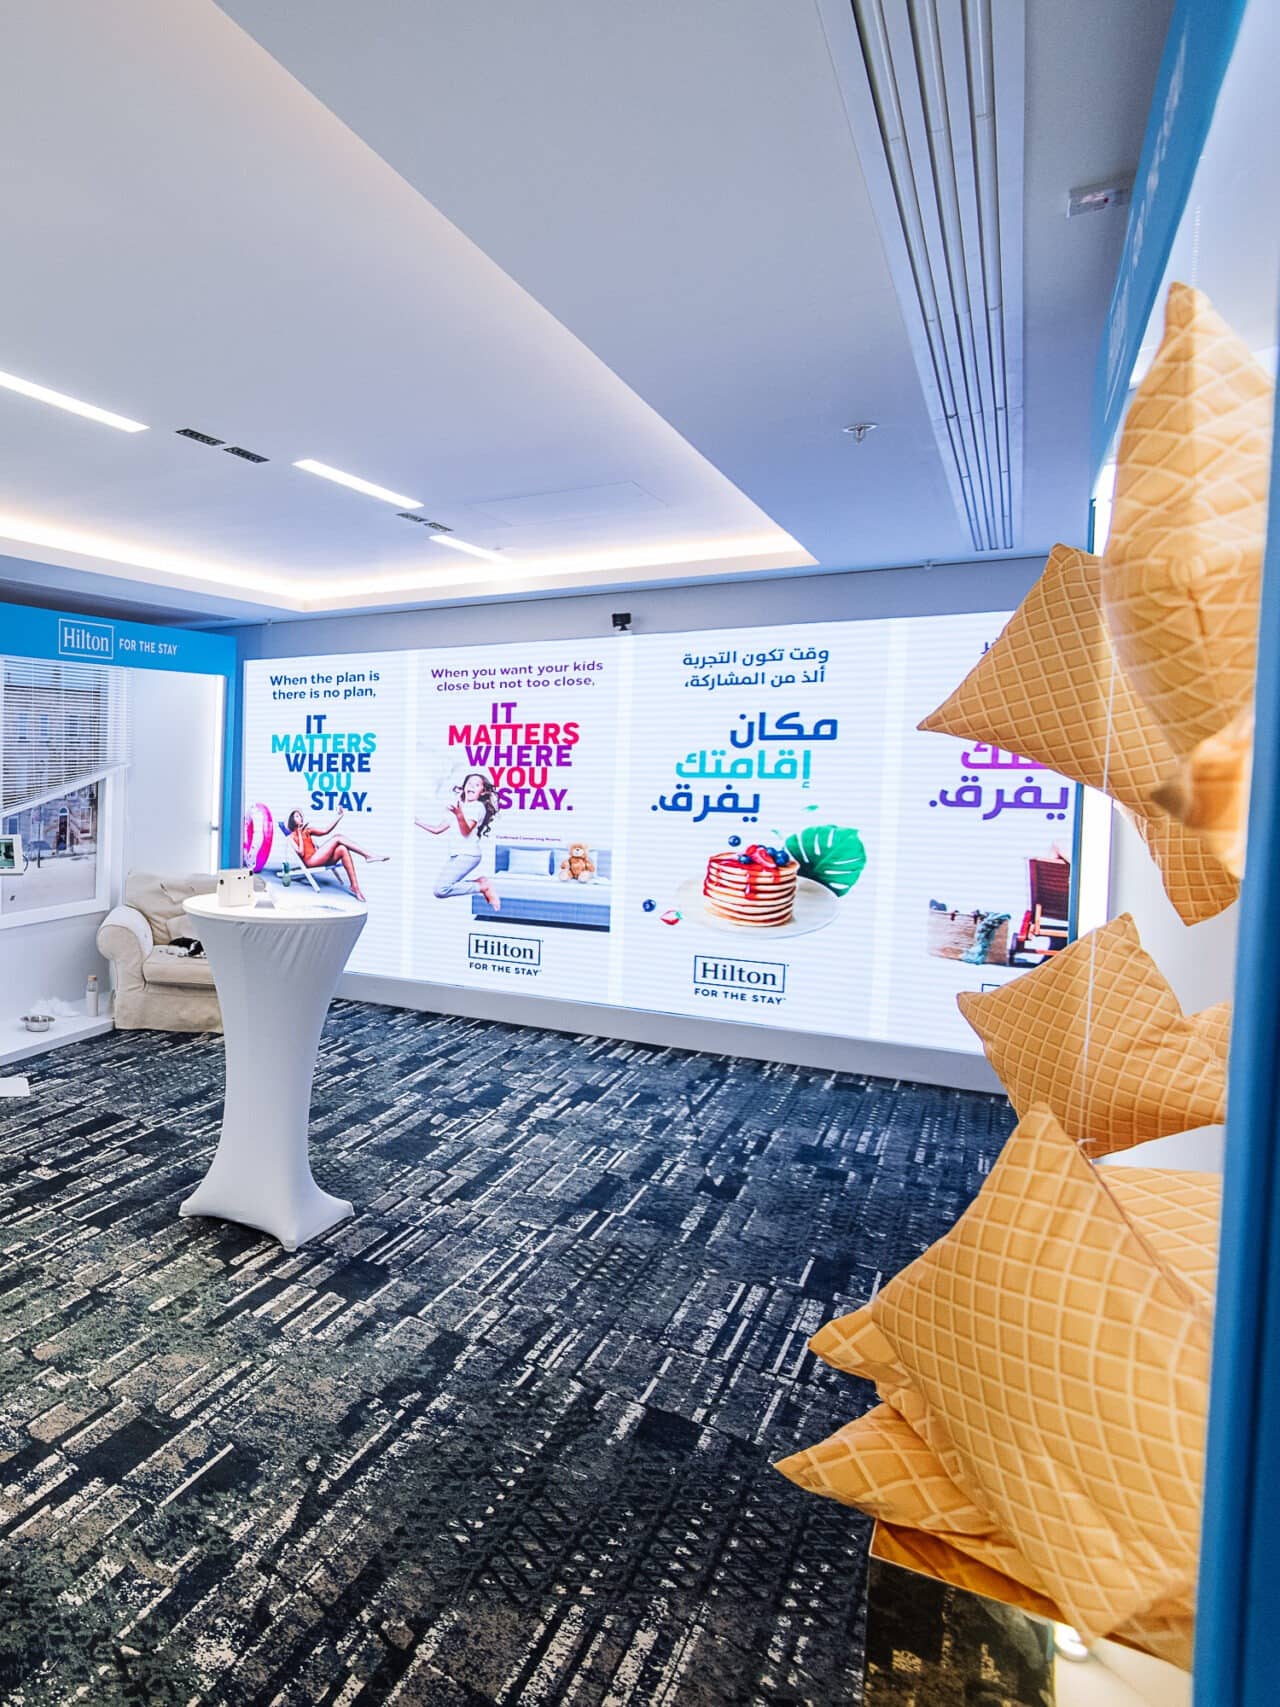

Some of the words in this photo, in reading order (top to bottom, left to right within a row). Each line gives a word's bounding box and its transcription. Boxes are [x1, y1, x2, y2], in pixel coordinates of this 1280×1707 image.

[63, 627, 110, 652] Hilton
[119, 638, 136, 652] FOR
[139, 640, 156, 653] THE
[158, 643, 178, 655] STAY
[683, 651, 737, 669] التجربة
[742, 648, 785, 666] تكون
[789, 647, 829, 664] وقت
[270, 675, 307, 686] When
[311, 673, 333, 684] the
[336, 672, 365, 685] plan
[369, 670, 380, 681] is
[431, 668, 468, 679] When
[472, 668, 496, 680] you
[500, 665, 533, 675] want
[537, 662, 569, 676] your
[573, 661, 603, 672] kids
[771, 673, 796, 688] من
[801, 665, 825, 683] ألذ
[436, 681, 470, 692] close
[473, 680, 495, 690] but
[500, 679, 522, 689] not
[526, 678, 550, 688] too
[554, 676, 595, 687] close,
[685, 672, 765, 691] المشاركة،
[273, 690, 306, 700] there
[310, 688, 320, 699] is
[323, 690, 340, 698] no
[344, 686, 376, 700] plan,
[492, 702, 517, 723] IT
[306, 715, 327, 734] IT
[448, 722, 580, 745] MATTERS
[730, 712, 838, 748] مكان
[272, 733, 377, 753] MATTERS
[285, 753, 371, 772] WHERE
[465, 745, 572, 767] WHERE
[488, 767, 548, 788] YOU
[676, 750, 812, 788] إقامتك
[304, 772, 352, 792] YOU
[311, 791, 372, 812] STAY.
[497, 788, 573, 811] STAY.
[651, 783, 760, 822] يفرق.
[929, 775, 1069, 820] يفرق.
[474, 939, 533, 959] Hilton
[469, 962, 488, 971] FOR
[492, 964, 511, 973] THE
[515, 967, 538, 976] STAY
[702, 962, 776, 985] Hilton
[694, 988, 718, 997] FOR
[723, 991, 746, 1001] THE
[752, 995, 782, 1005] STAY
